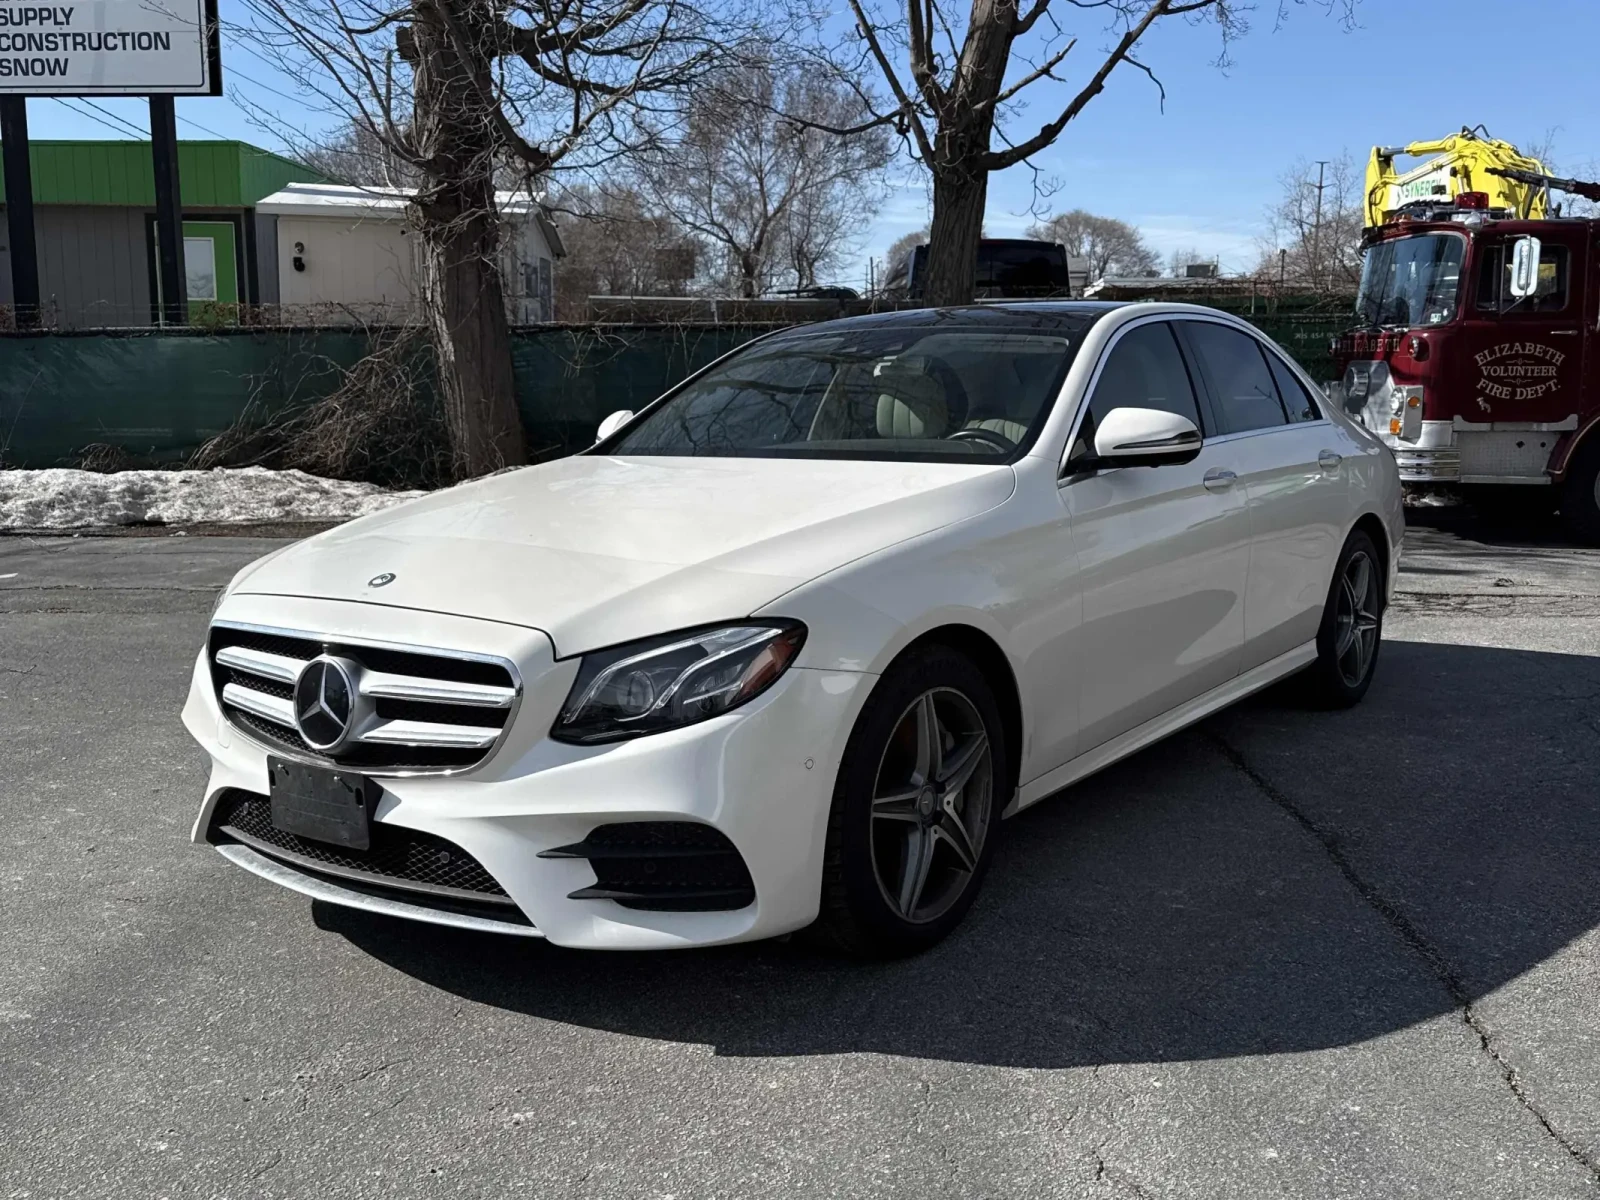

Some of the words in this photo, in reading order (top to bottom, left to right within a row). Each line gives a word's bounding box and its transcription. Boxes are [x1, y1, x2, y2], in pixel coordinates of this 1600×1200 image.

[0, 7, 74, 26] SUPPLY
[0, 32, 170, 51] CONSTRUCTION
[0, 58, 69, 76] SNOW
[1342, 338, 1400, 352] ELIZABETH
[1474, 342, 1565, 366] ELIZABETH
[1481, 365, 1557, 376] VOLUNTEER
[1476, 378, 1512, 399] FIRE
[1514, 379, 1561, 400] DEPT.
